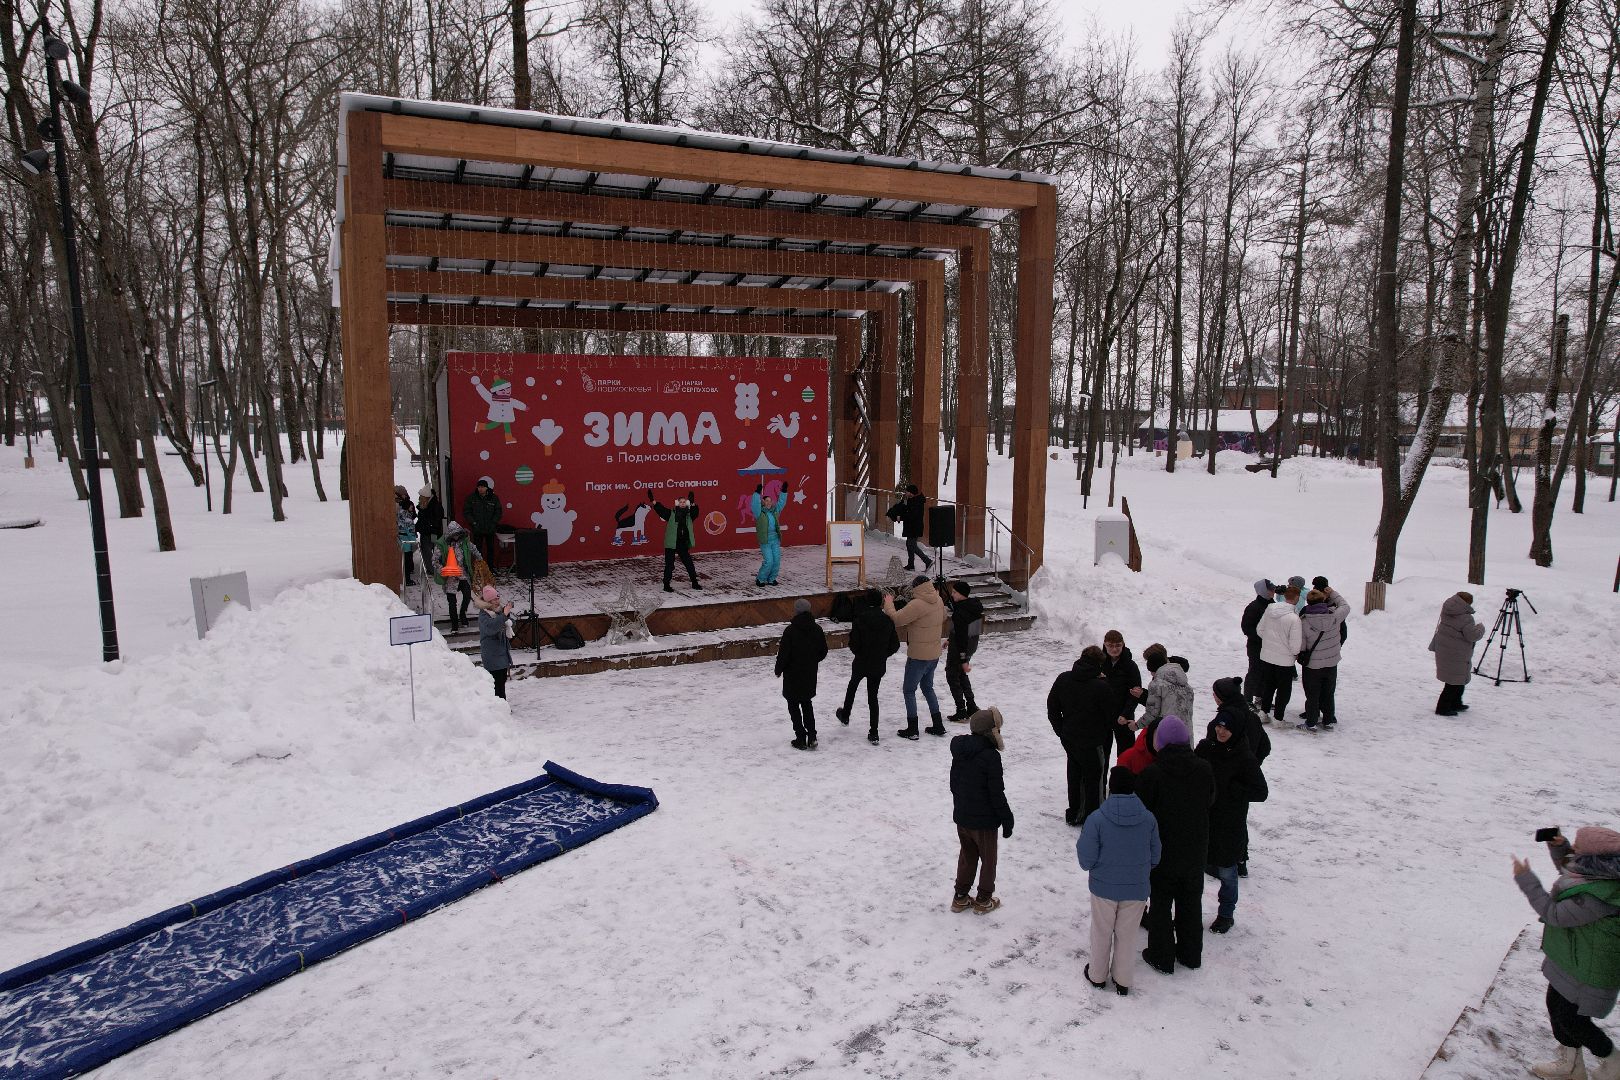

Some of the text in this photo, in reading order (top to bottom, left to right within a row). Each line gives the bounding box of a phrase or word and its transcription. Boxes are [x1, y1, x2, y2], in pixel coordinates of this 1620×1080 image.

[583, 411, 722, 447] ЗИМА
[606, 452, 702, 464] в Подмосковье
[585, 481, 612, 493] Парк
[633, 480, 664, 489] Олега
[666, 479, 719, 489] Степанова
